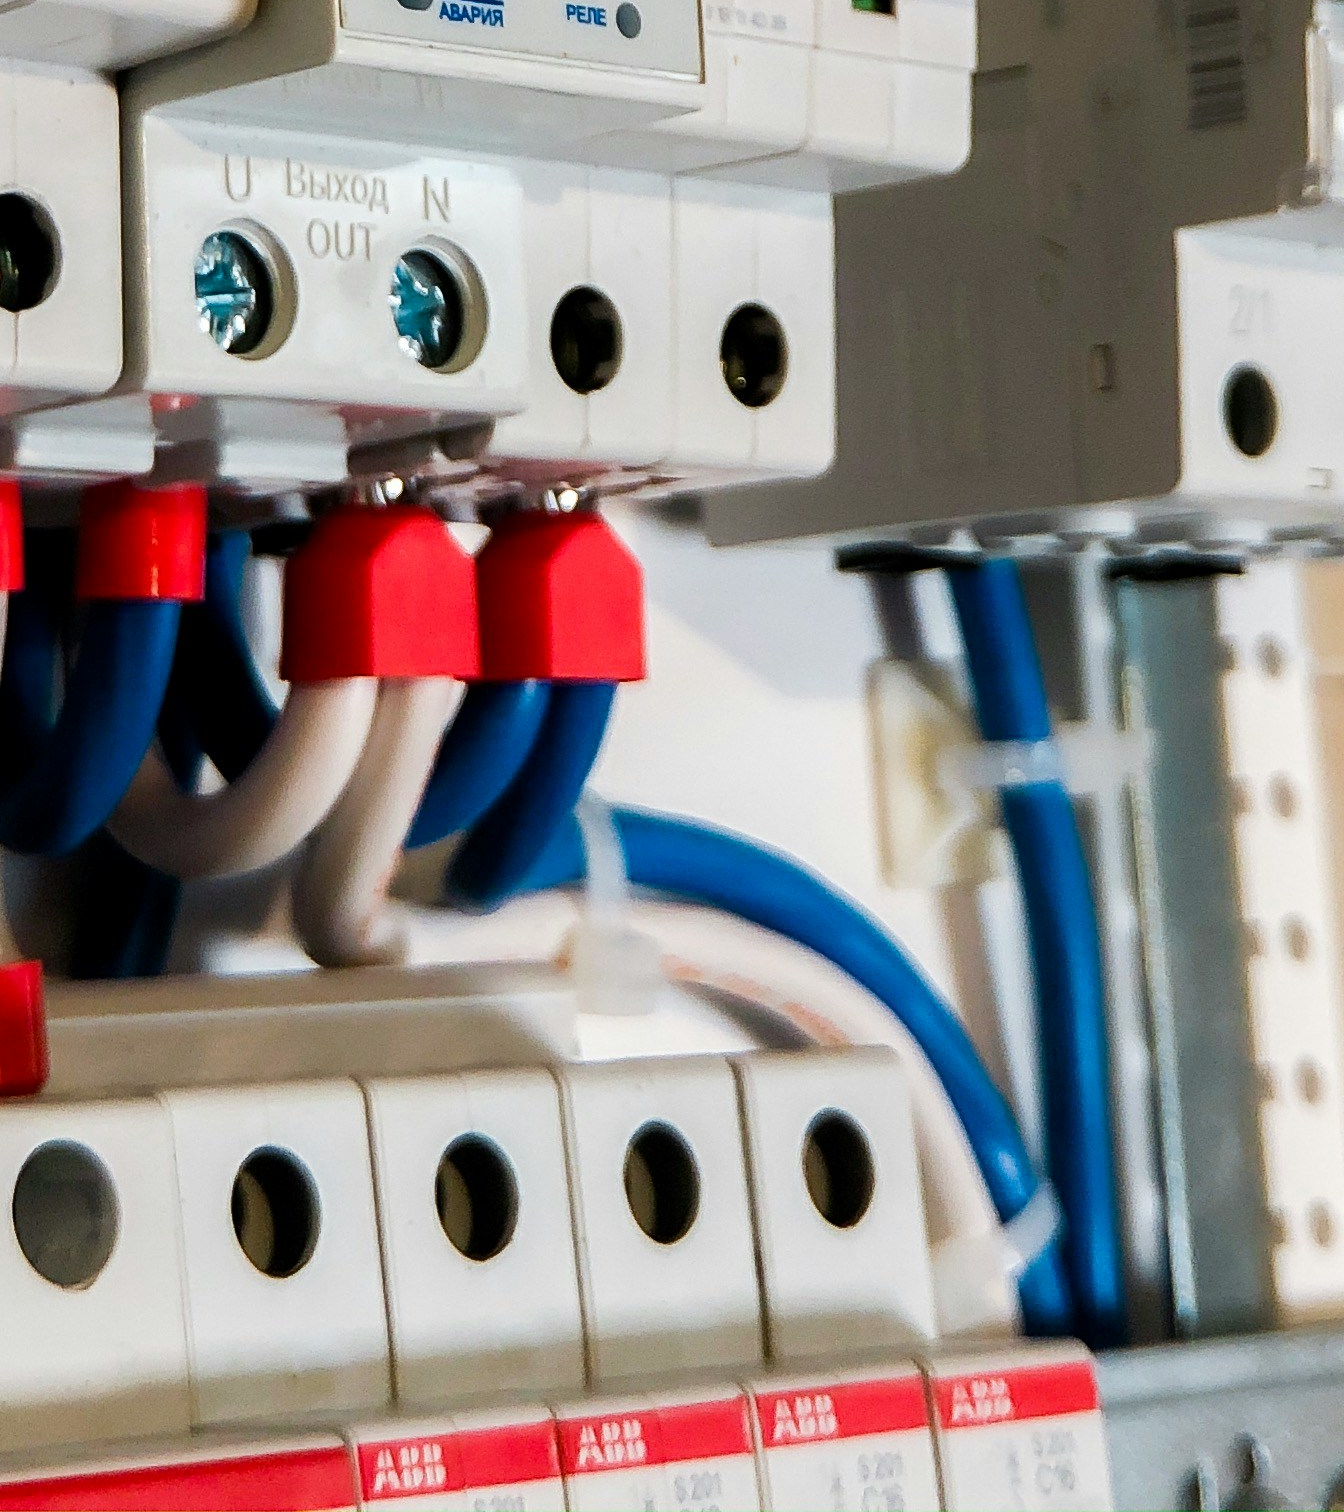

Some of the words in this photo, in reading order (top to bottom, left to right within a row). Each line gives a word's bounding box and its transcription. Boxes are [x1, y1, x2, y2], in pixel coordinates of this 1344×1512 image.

[438, 2, 505, 28] АВАРИЯ
[566, 4, 607, 27] РЕЛЕ
[223, 153, 252, 203] U
[284, 156, 390, 214] Выход
[421, 173, 450, 223] N
[306, 217, 377, 262] OUT
[773, 1394, 838, 1441] ABB
[951, 1378, 1014, 1422] ABB
[372, 1443, 448, 1493] ABB
[577, 1419, 647, 1469] ABB
